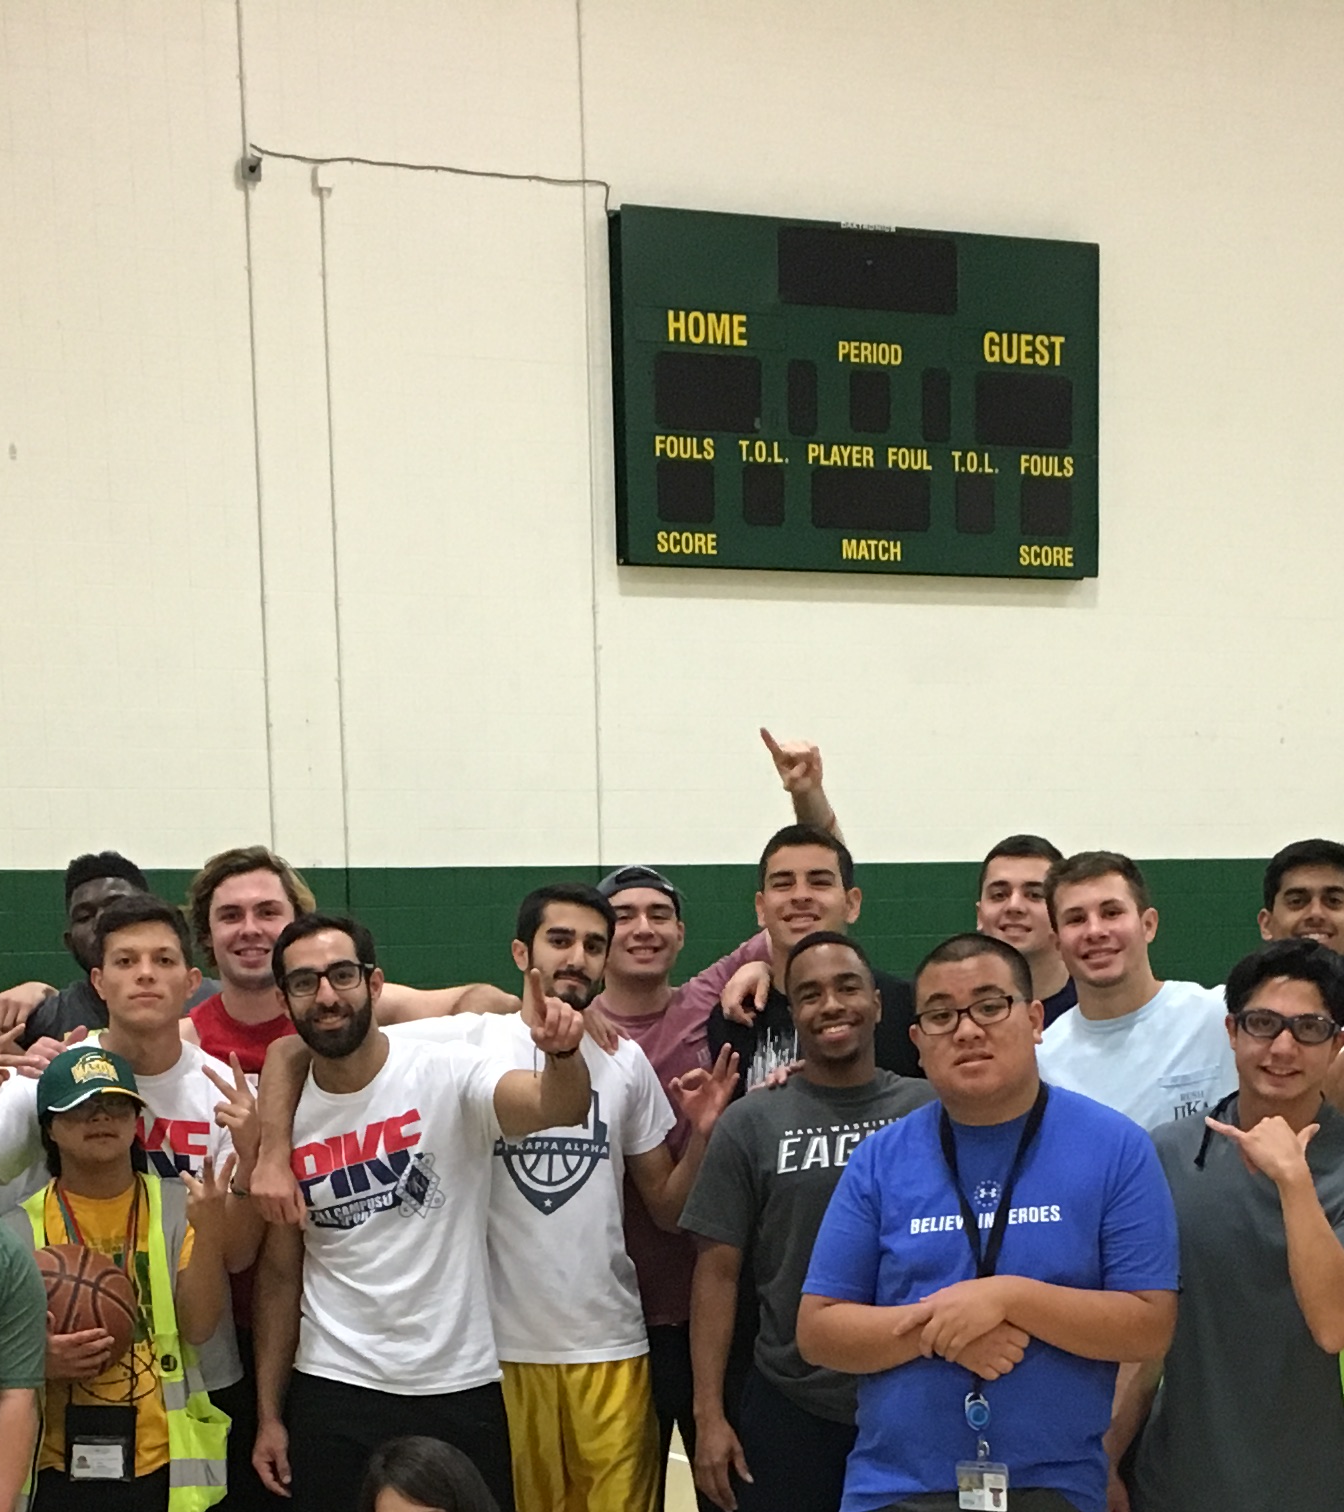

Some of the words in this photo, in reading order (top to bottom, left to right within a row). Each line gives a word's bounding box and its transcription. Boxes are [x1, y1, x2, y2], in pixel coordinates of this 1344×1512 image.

[667, 309, 748, 347] HOME
[838, 340, 902, 366] PERIOD
[983, 331, 1065, 367] GUEST
[655, 435, 715, 460] FOULS
[738, 439, 789, 464] T.O.L.
[808, 443, 875, 468] PLAYER
[887, 447, 933, 471] FOUL
[951, 450, 999, 474] T.O.L.
[1020, 454, 1074, 478] FOULS
[657, 530, 718, 555] SCORE
[842, 538, 902, 562] MATCH
[1019, 544, 1074, 567] SCORE
[784, 1127, 822, 1136] MARY
[516, 1141, 559, 1152] KAPPA
[564, 1141, 609, 1154] ALPHA
[777, 1129, 875, 1174] EAG
[910, 1214, 965, 1235] BELIEV
[978, 1211, 995, 1229] IN
[1008, 1204, 1061, 1225] EROES
